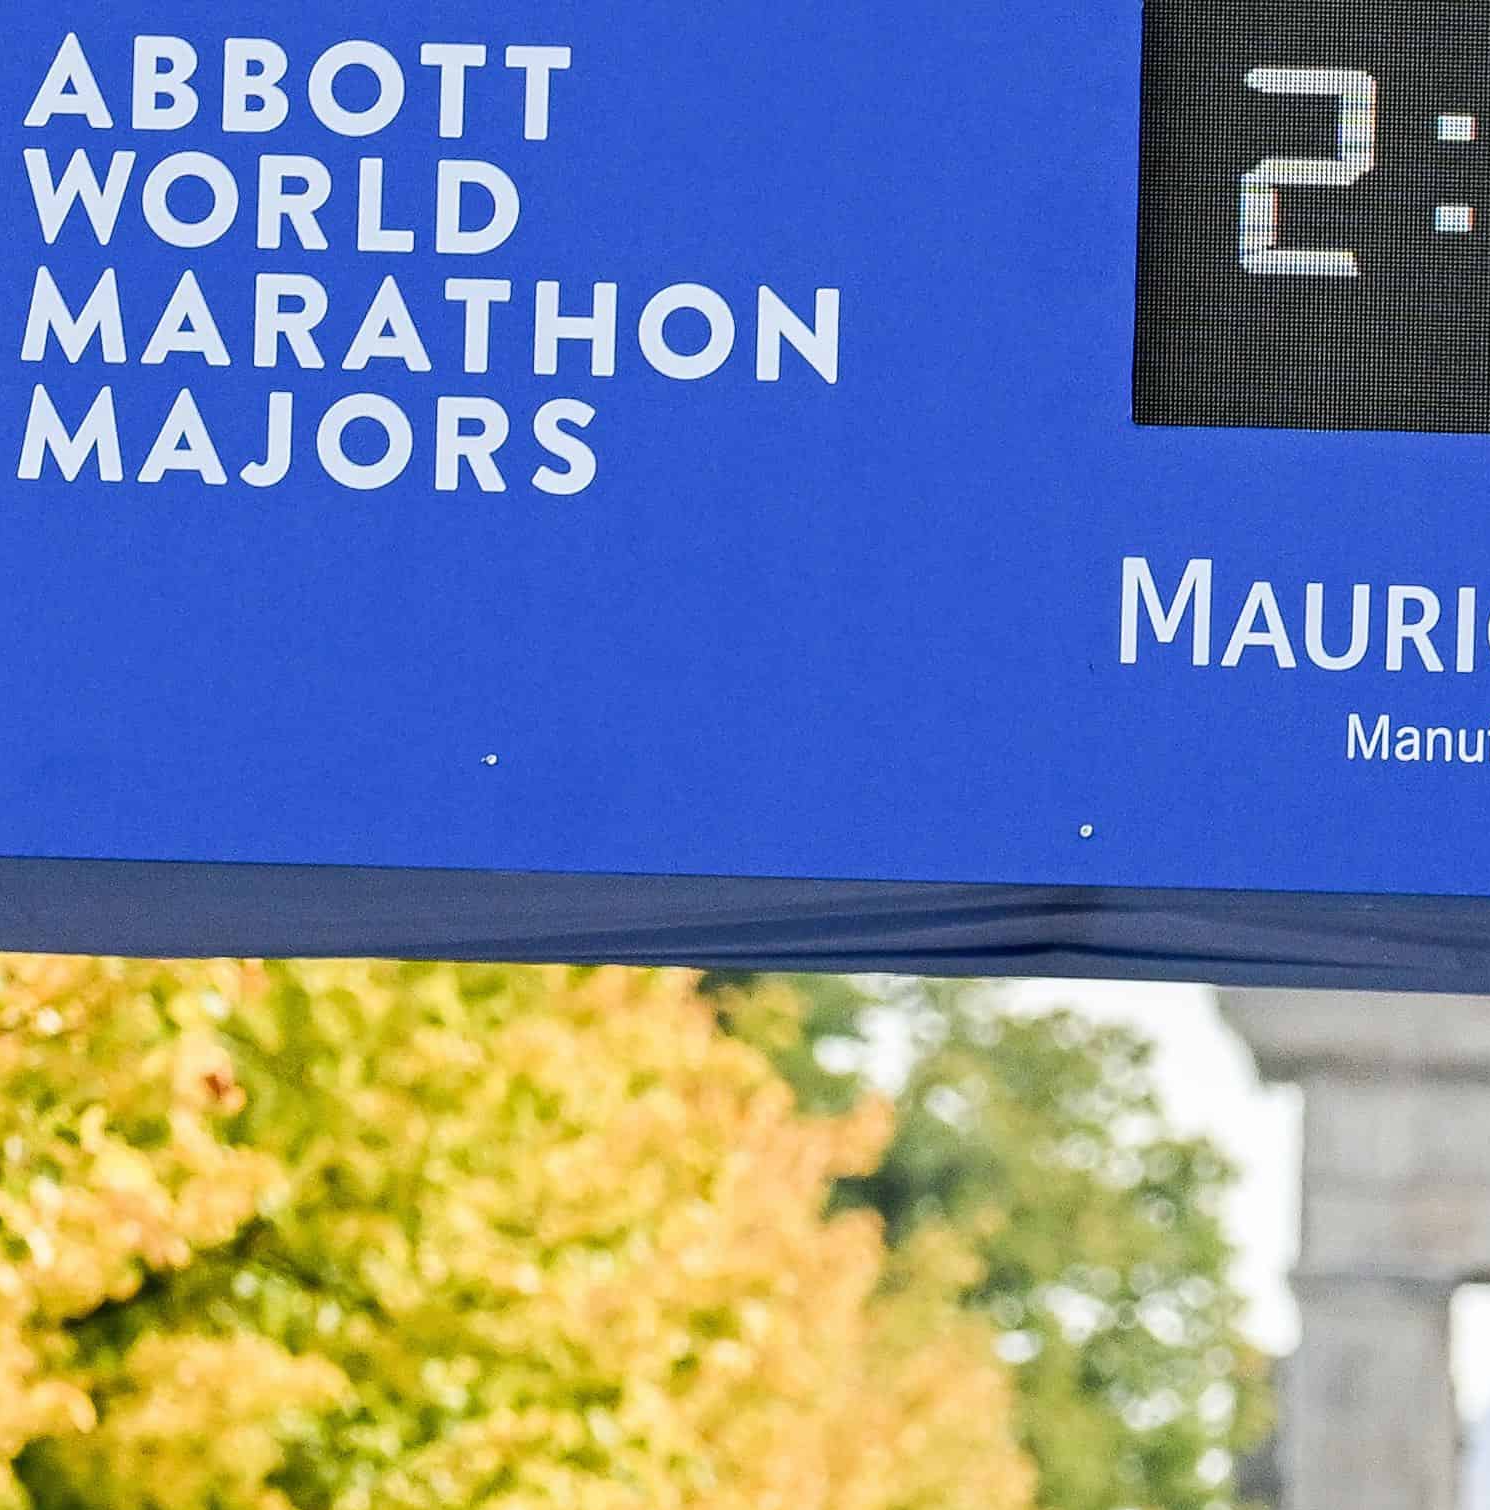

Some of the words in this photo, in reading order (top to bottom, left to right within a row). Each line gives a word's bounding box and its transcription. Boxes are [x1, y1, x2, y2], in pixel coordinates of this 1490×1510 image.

[22, 31, 572, 141] ABBOTT
[22, 147, 521, 256] WORLD
[18, 265, 841, 386] MARATHON
[16, 383, 597, 496] MAJORS
